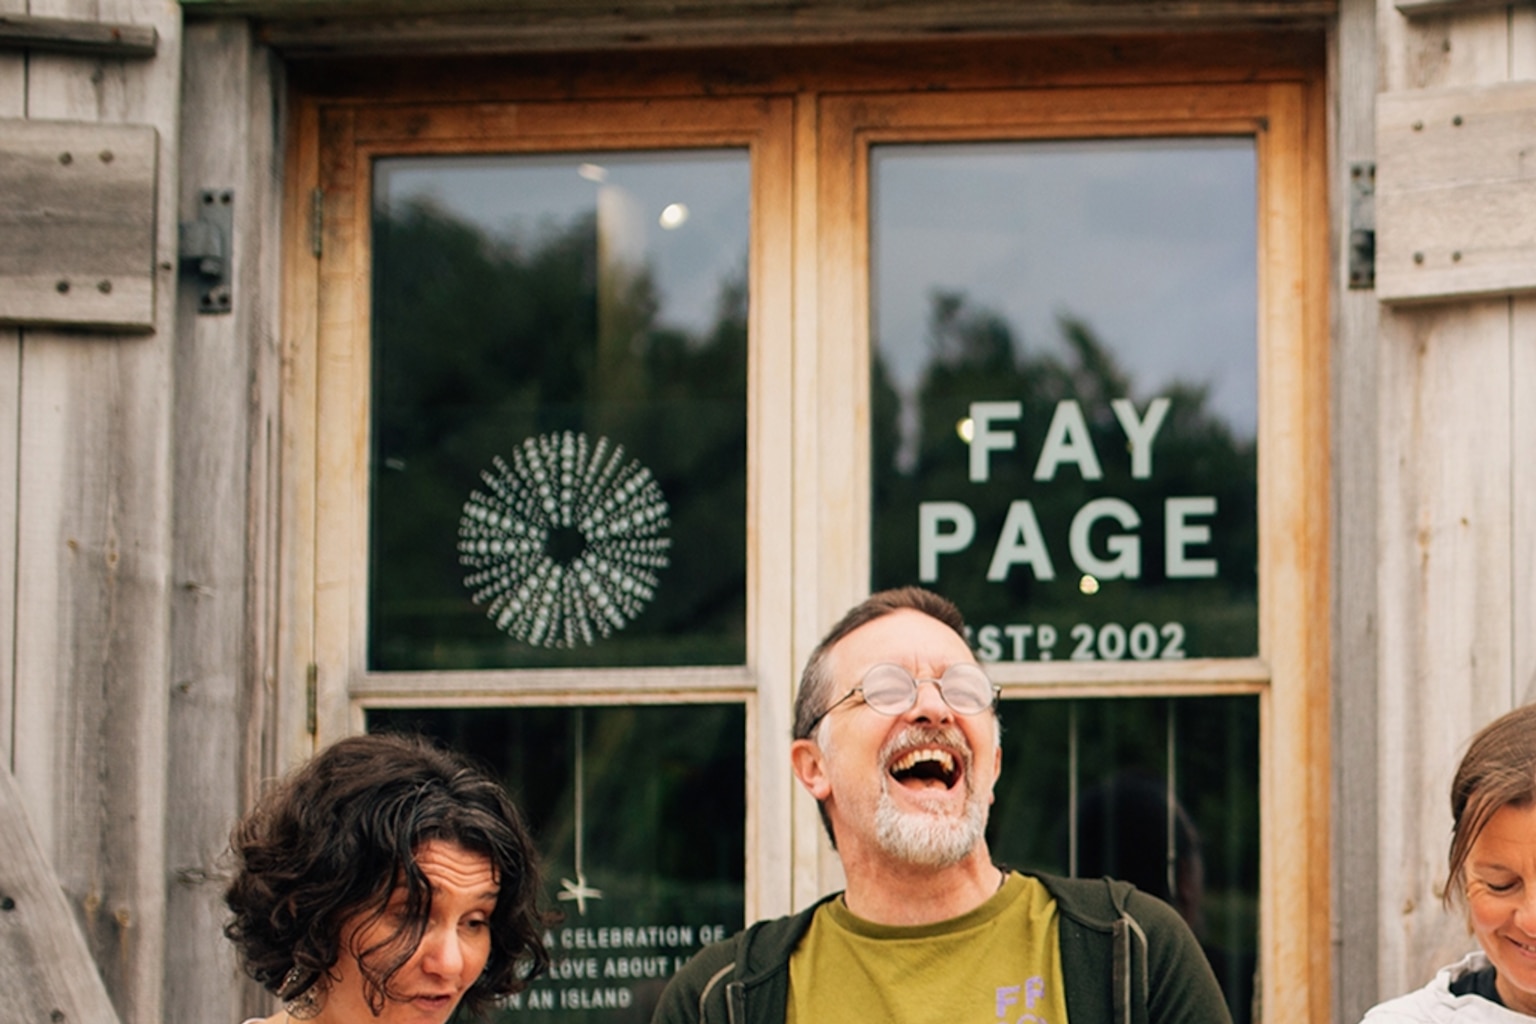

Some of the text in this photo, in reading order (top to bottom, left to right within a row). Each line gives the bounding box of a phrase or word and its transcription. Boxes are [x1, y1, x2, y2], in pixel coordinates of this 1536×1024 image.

[969, 398, 1170, 483] FAY
[918, 497, 1218, 583] PAGE
[1070, 622, 1186, 660] 2002
[561, 925, 693, 949] CELEBRATION
[700, 924, 725, 946] OF
[549, 957, 598, 979] LOVE
[604, 956, 667, 978] ABOUT
[528, 990, 553, 1010] AN
[561, 987, 632, 1009] ISLAND
